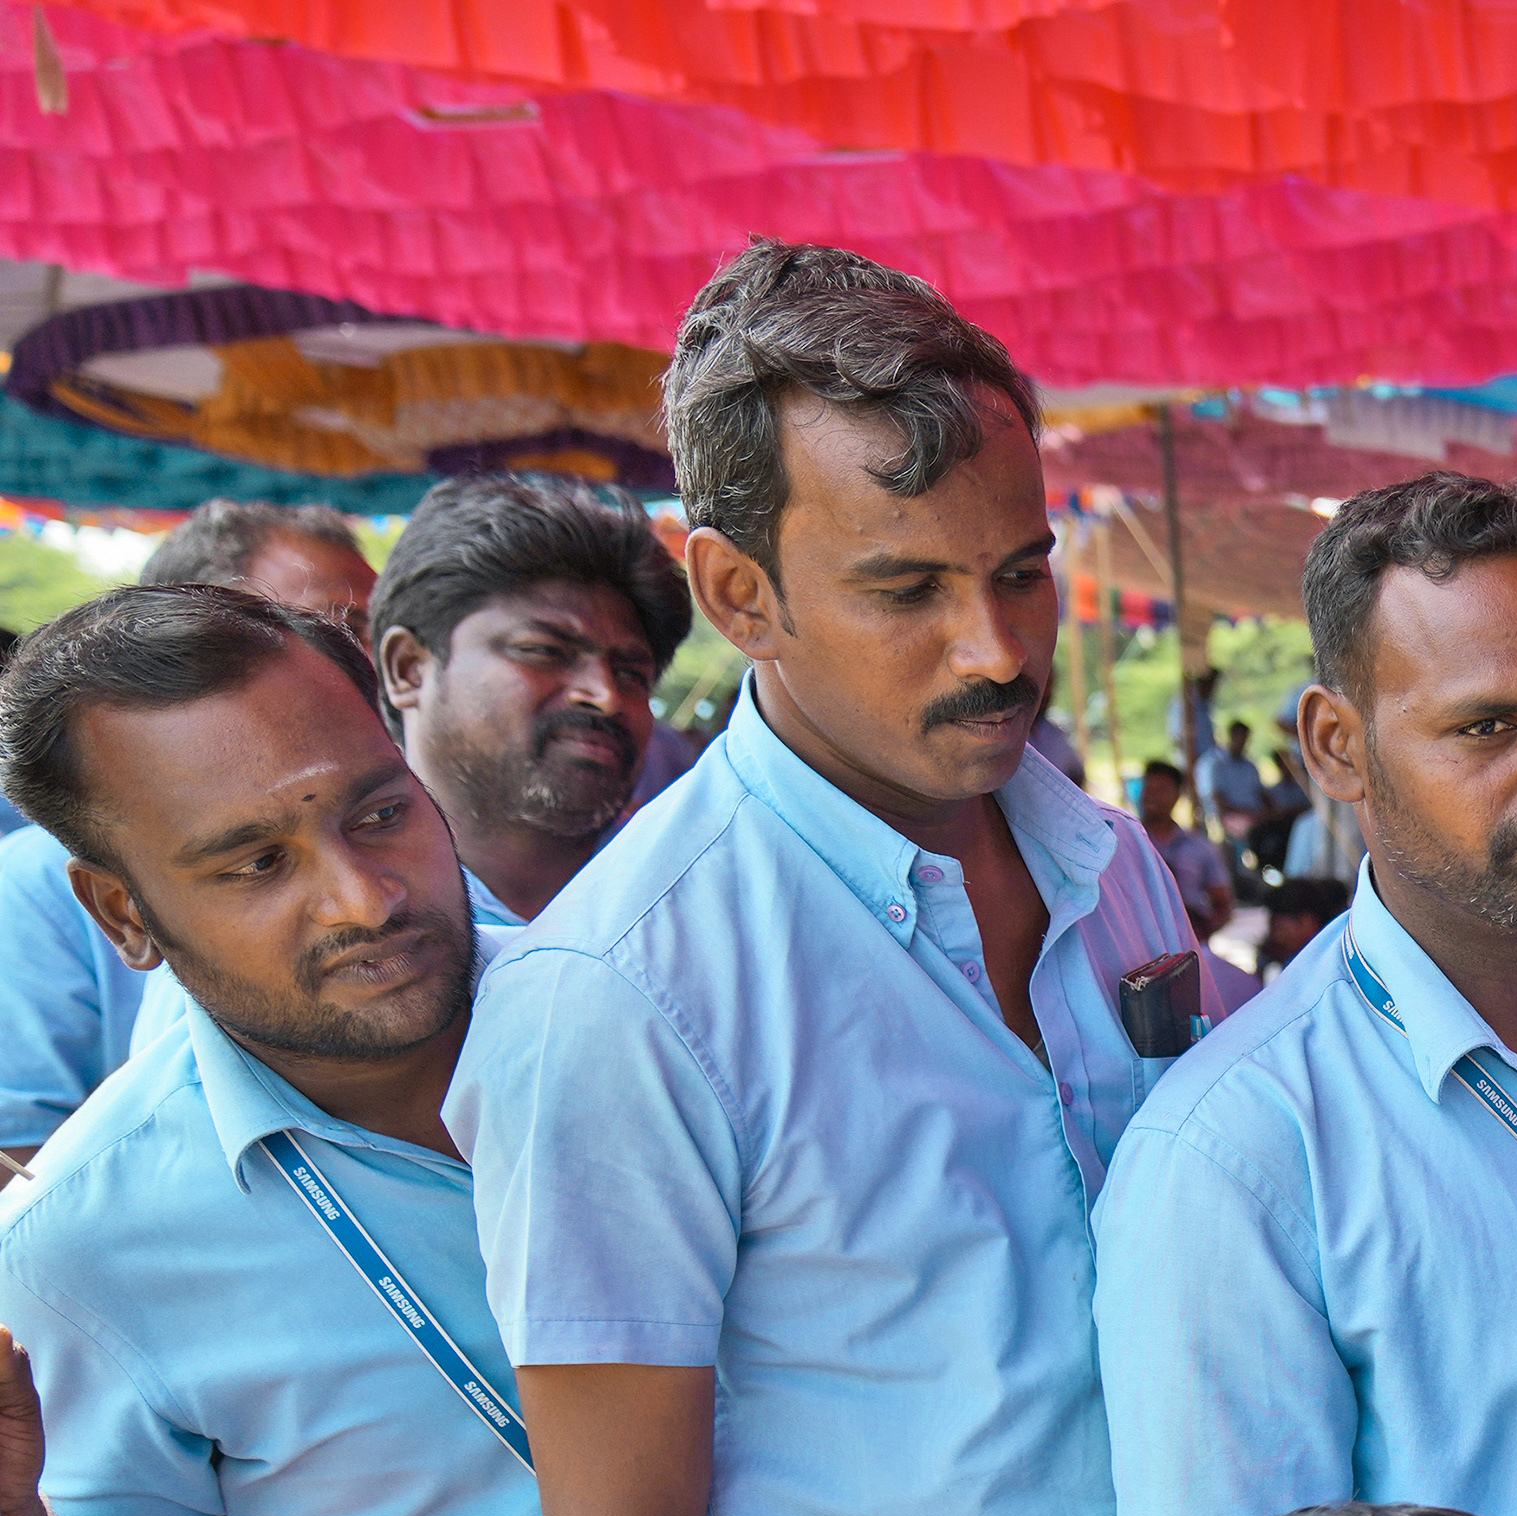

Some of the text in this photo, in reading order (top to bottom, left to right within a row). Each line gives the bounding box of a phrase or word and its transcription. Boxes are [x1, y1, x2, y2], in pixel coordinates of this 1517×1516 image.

[292, 1165, 341, 1222] SAMSUNG
[378, 1275, 427, 1330] SAMSUNG
[463, 1380, 511, 1429] SAMSUNG
